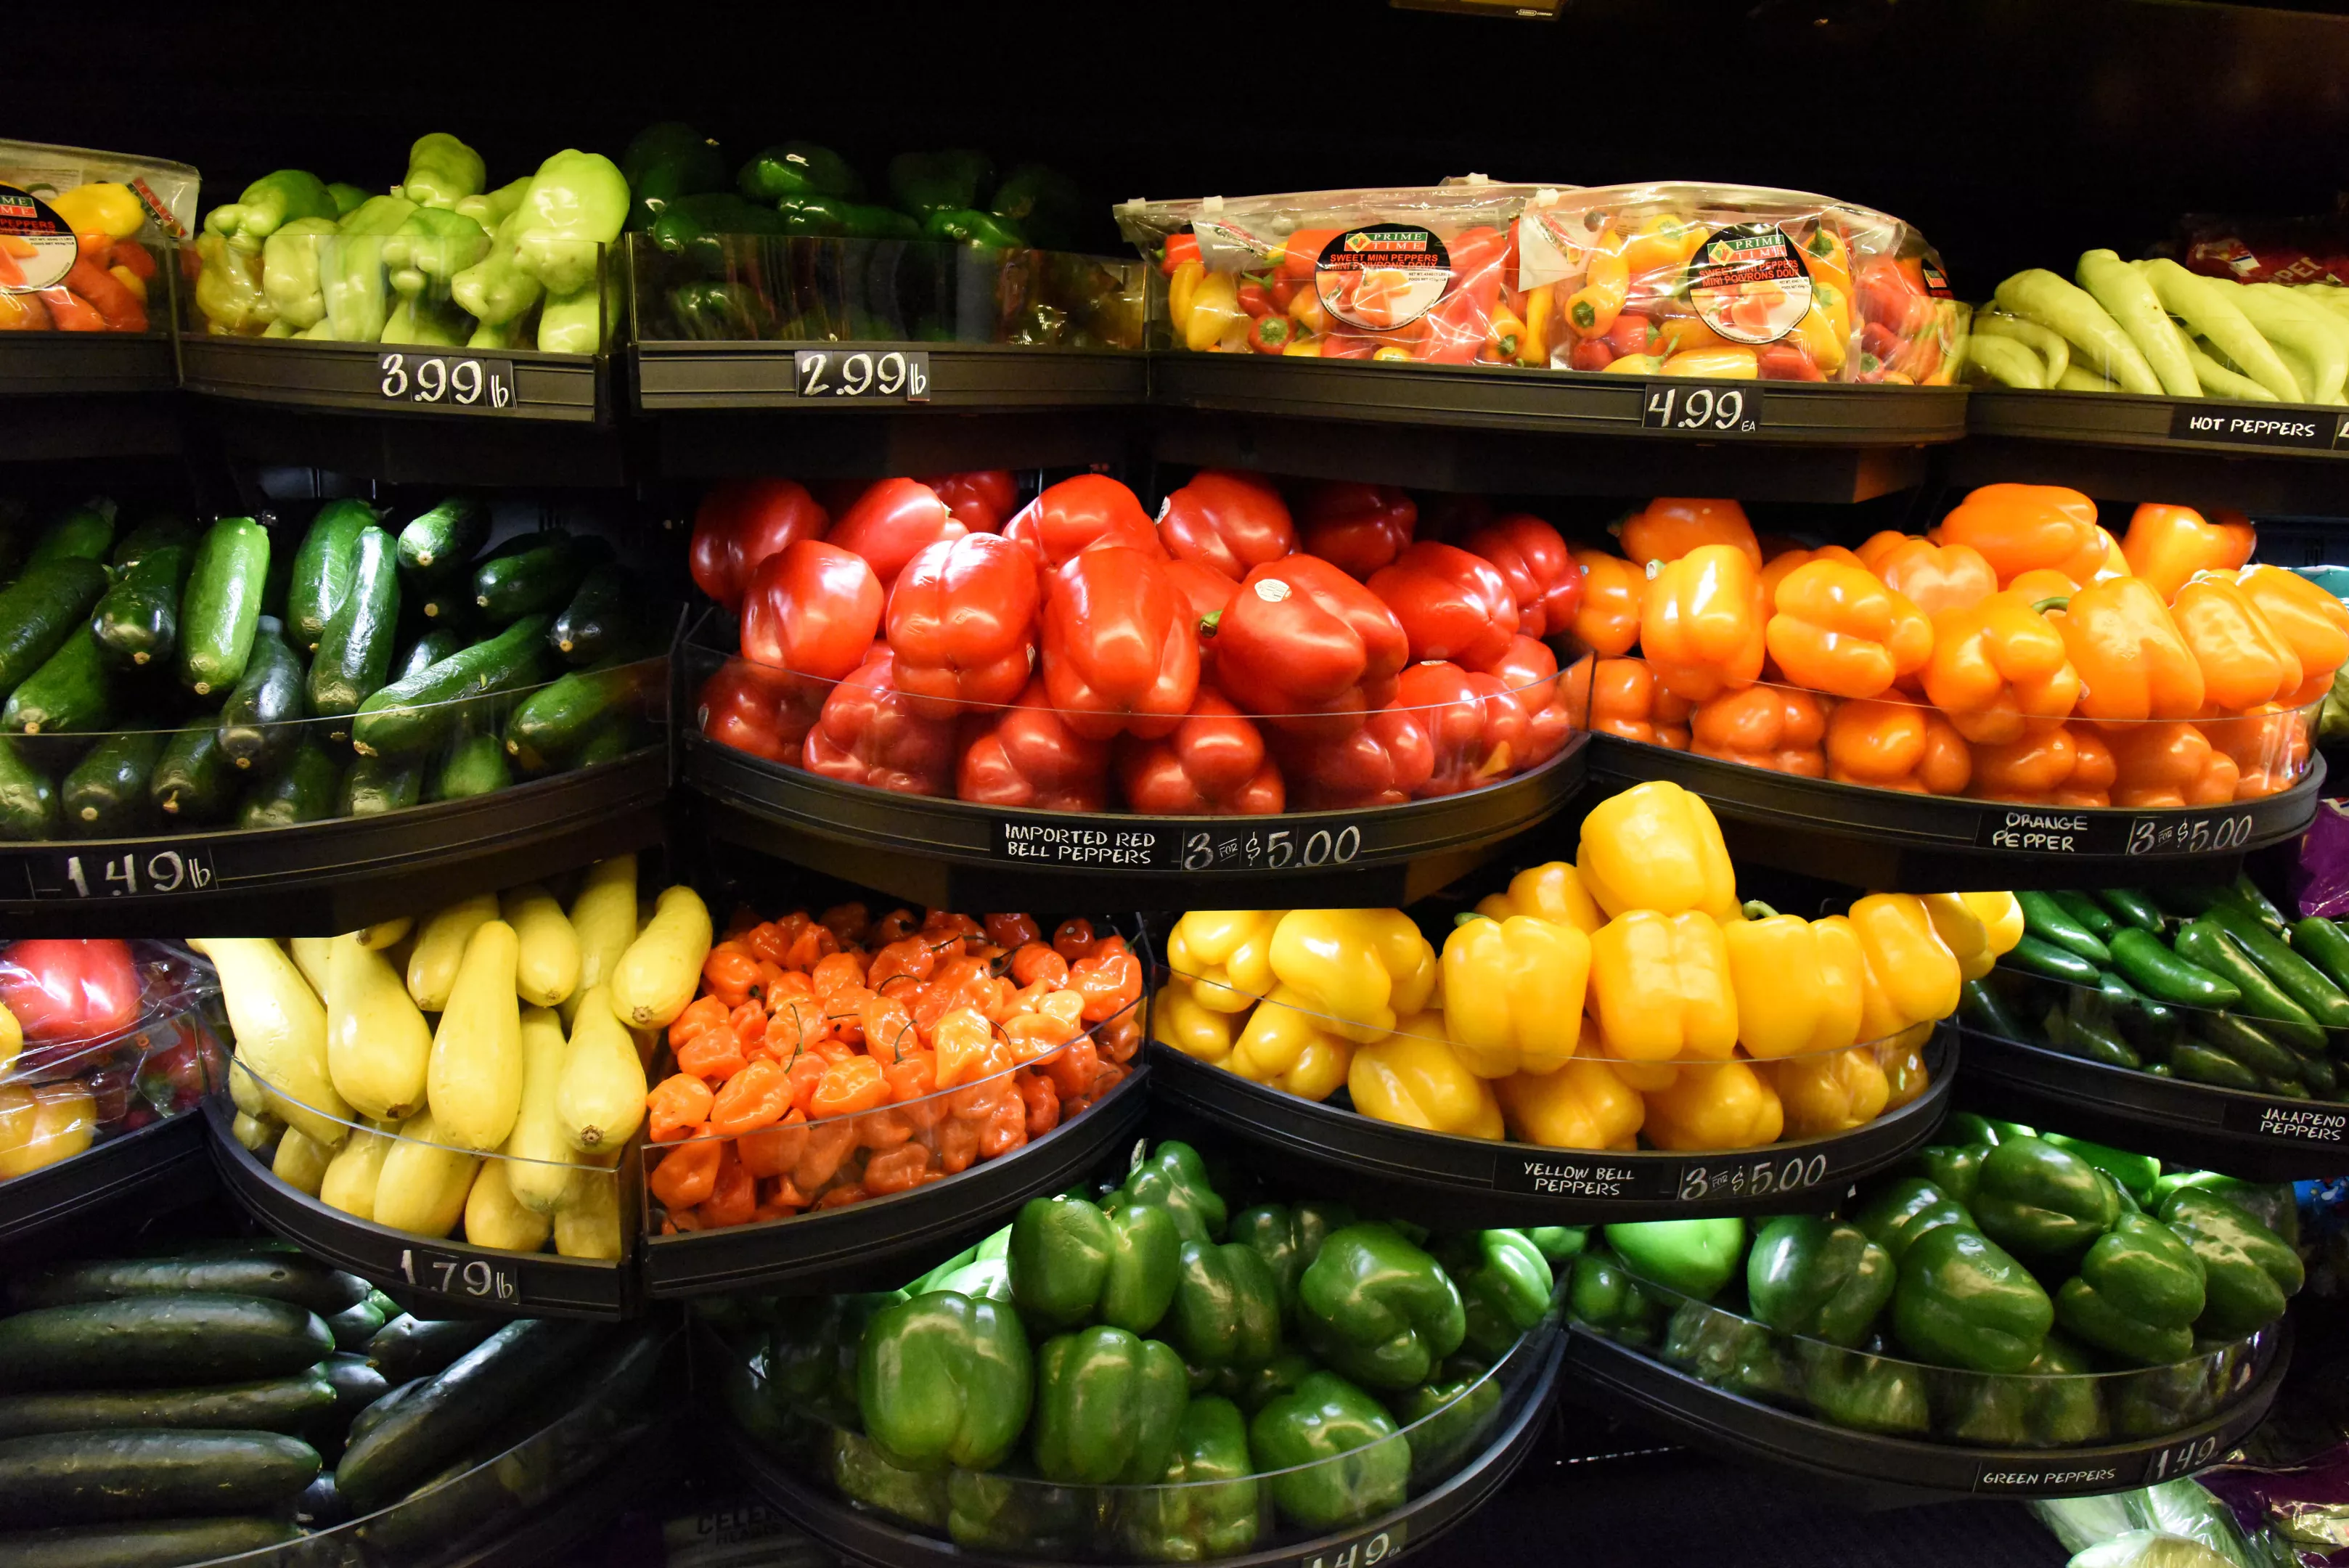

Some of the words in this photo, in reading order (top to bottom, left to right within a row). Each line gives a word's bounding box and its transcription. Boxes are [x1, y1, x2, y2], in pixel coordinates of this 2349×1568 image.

[1736, 236, 1783, 250] PRIME
[1736, 245, 1784, 260] TIME
[1699, 267, 1733, 279] SWEET
[1759, 260, 1799, 271] PEPPERS
[1702, 277, 1723, 287] MINI
[1725, 271, 1775, 285] POIVRONS
[1776, 268, 1799, 278] DOUX
[382, 354, 482, 404] 3.99
[491, 375, 509, 408] lb
[801, 352, 906, 396] 2.99
[910, 363, 926, 396] lb
[1648, 388, 1743, 430] 4.99
[1742, 420, 1755, 432] EA
[2190, 417, 2225, 430] HOT
[2230, 419, 2316, 436] PEPPERS
[2006, 812, 2088, 830] ORANGE
[1005, 823, 1108, 845] IMPORTED
[1116, 833, 1156, 847] RED
[1993, 830, 2075, 852] PEPPER
[2130, 822, 2155, 855] 3
[2158, 829, 2173, 844] FOR
[1008, 841, 1050, 857] BELL
[1058, 846, 1151, 864] PEPPERS
[1185, 833, 1214, 870] 3
[1219, 842, 1238, 858] FOR
[68, 851, 184, 897] 1.49
[189, 858, 211, 889] lb
[2261, 1108, 2346, 1127] JALAPENO
[2260, 1120, 2342, 1140] PEPPERS
[1524, 1161, 1590, 1180] YELLOW
[1596, 1167, 1635, 1180] BELL
[1535, 1178, 1620, 1196] PEPPERS
[1681, 1167, 1708, 1201] 3
[1712, 1175, 1728, 1188] FOR
[401, 1249, 491, 1296] 1.79
[497, 1272, 513, 1299] lb
[2157, 1437, 2216, 1480] 1.49
[1983, 1472, 2038, 1485] GREEN
[2044, 1469, 2117, 1484] PEPPERS
